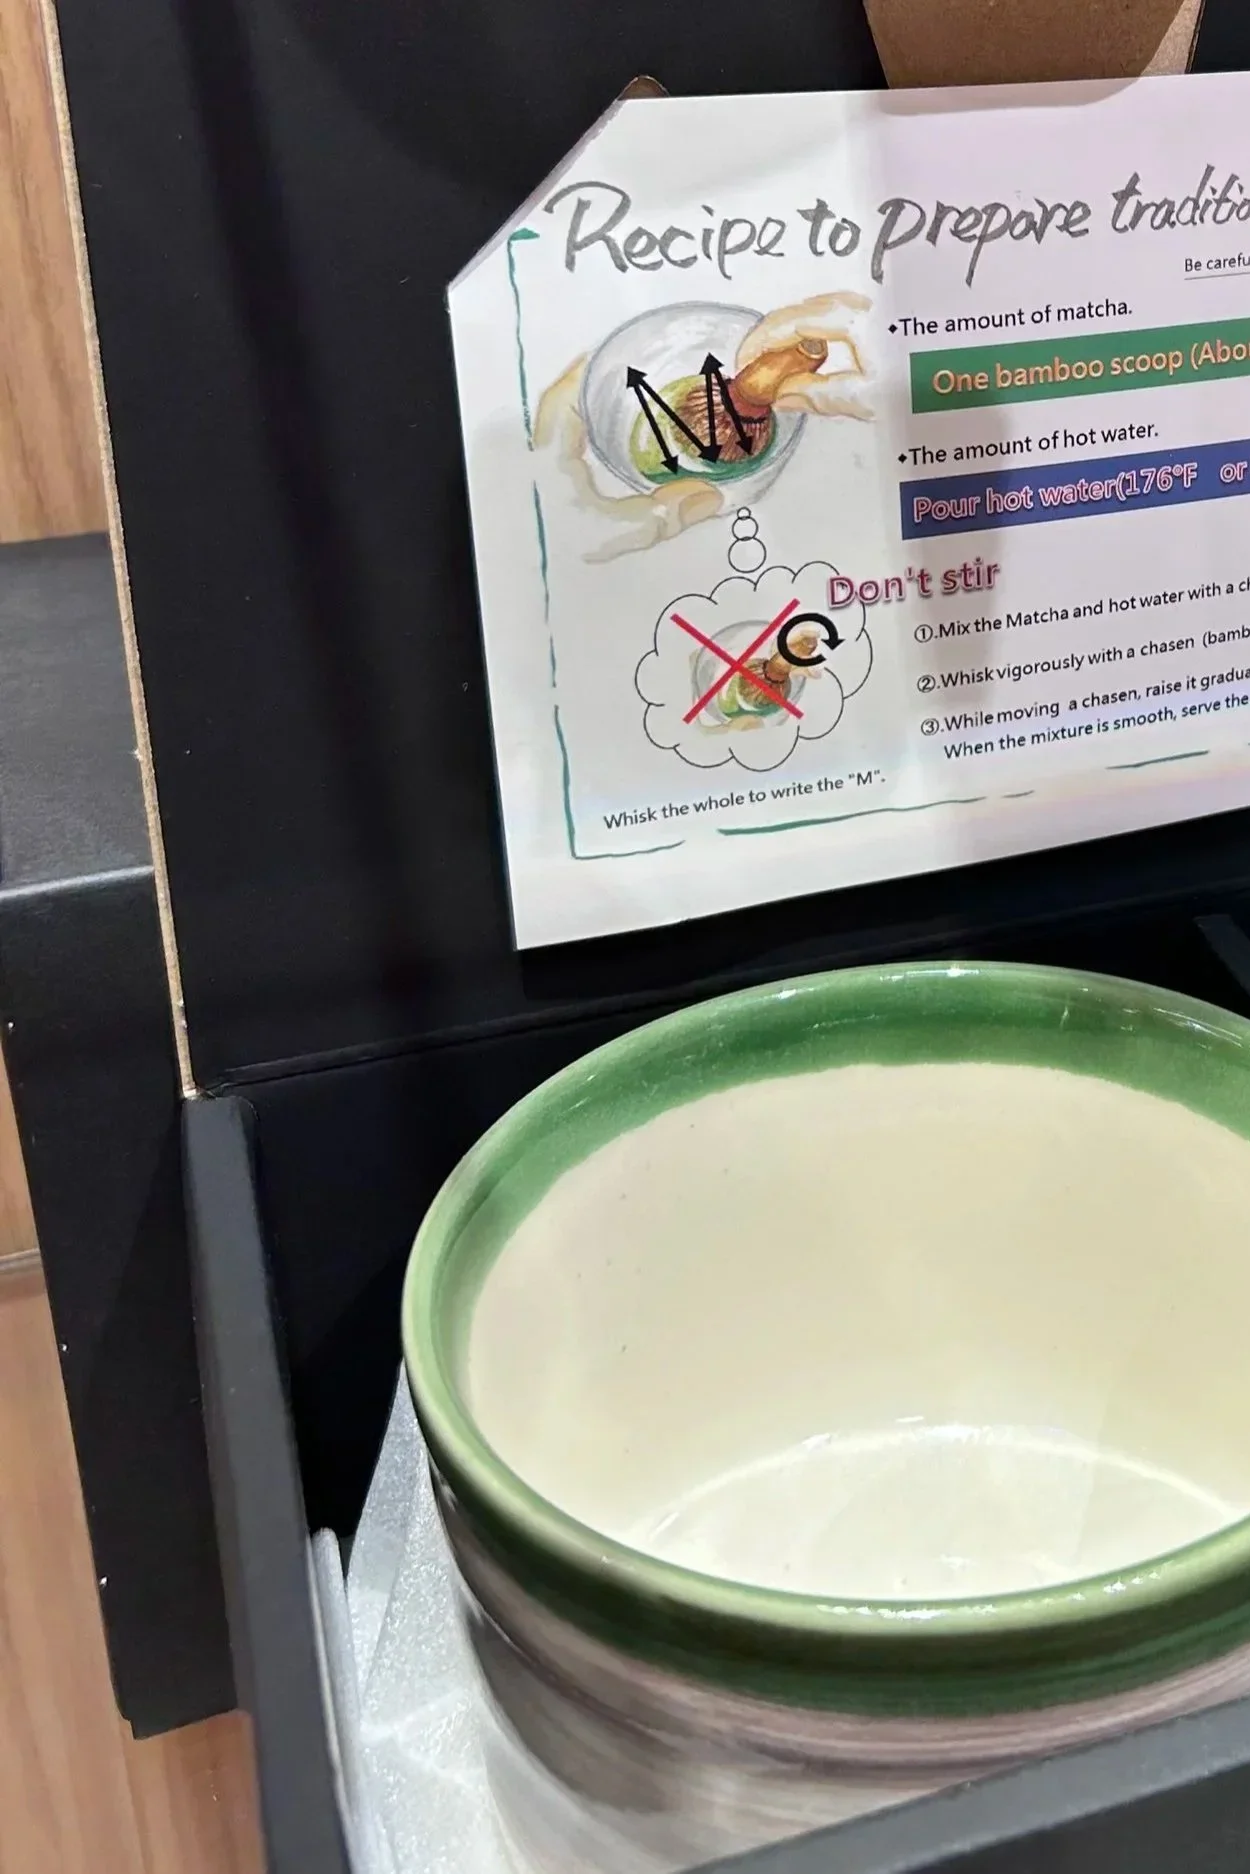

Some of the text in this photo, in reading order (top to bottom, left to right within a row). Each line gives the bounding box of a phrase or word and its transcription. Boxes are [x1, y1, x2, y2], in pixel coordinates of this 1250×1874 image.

[543, 181, 787, 280] Recipe
[798, 199, 861, 256] to
[871, 197, 1091, 288] prepare
[1184, 257, 1202, 273] Be
[945, 309, 1026, 333] amount
[1031, 305, 1053, 325] of
[1056, 299, 1133, 323] matcha.
[931, 365, 990, 396] One
[995, 354, 1104, 389] bamboo
[1110, 350, 1184, 382] scoop
[953, 438, 1032, 461] amount
[1038, 433, 1060, 453] of
[1063, 428, 1096, 449] hot
[1101, 423, 1159, 444] water.
[913, 494, 978, 524] Pour
[986, 484, 1034, 514] hot
[1220, 462, 1247, 482] or
[828, 557, 1000, 610] Don't stir
[974, 613, 1002, 633] the
[1006, 606, 1069, 628] Matcha
[1073, 600, 1103, 618] and
[1108, 594, 1136, 613] hot
[1140, 591, 1184, 607] water
[1188, 583, 1221, 600] with
[1225, 584, 1234, 595] a
[996, 653, 1084, 681] vigorously
[1088, 646, 1123, 664] with
[1126, 649, 1135, 659] a
[1140, 635, 1194, 656] chasen
[997, 701, 1060, 725] moving
[1068, 700, 1077, 711] a
[1082, 688, 1142, 709] chasen,
[1146, 681, 1182, 697] raise
[1186, 675, 1197, 690] it
[945, 739, 994, 760] When
[999, 734, 1026, 750] the
[1031, 721, 1093, 744] mixture
[1097, 718, 1109, 733] is
[1113, 708, 1177, 731] smooth,
[1181, 702, 1220, 718] serve
[1225, 693, 1249, 710] the
[603, 809, 656, 830] Whisk
[662, 803, 689, 820] the
[693, 793, 745, 813] whole
[749, 789, 766, 803] to
[771, 782, 813, 800] write
[818, 777, 844, 793] the
